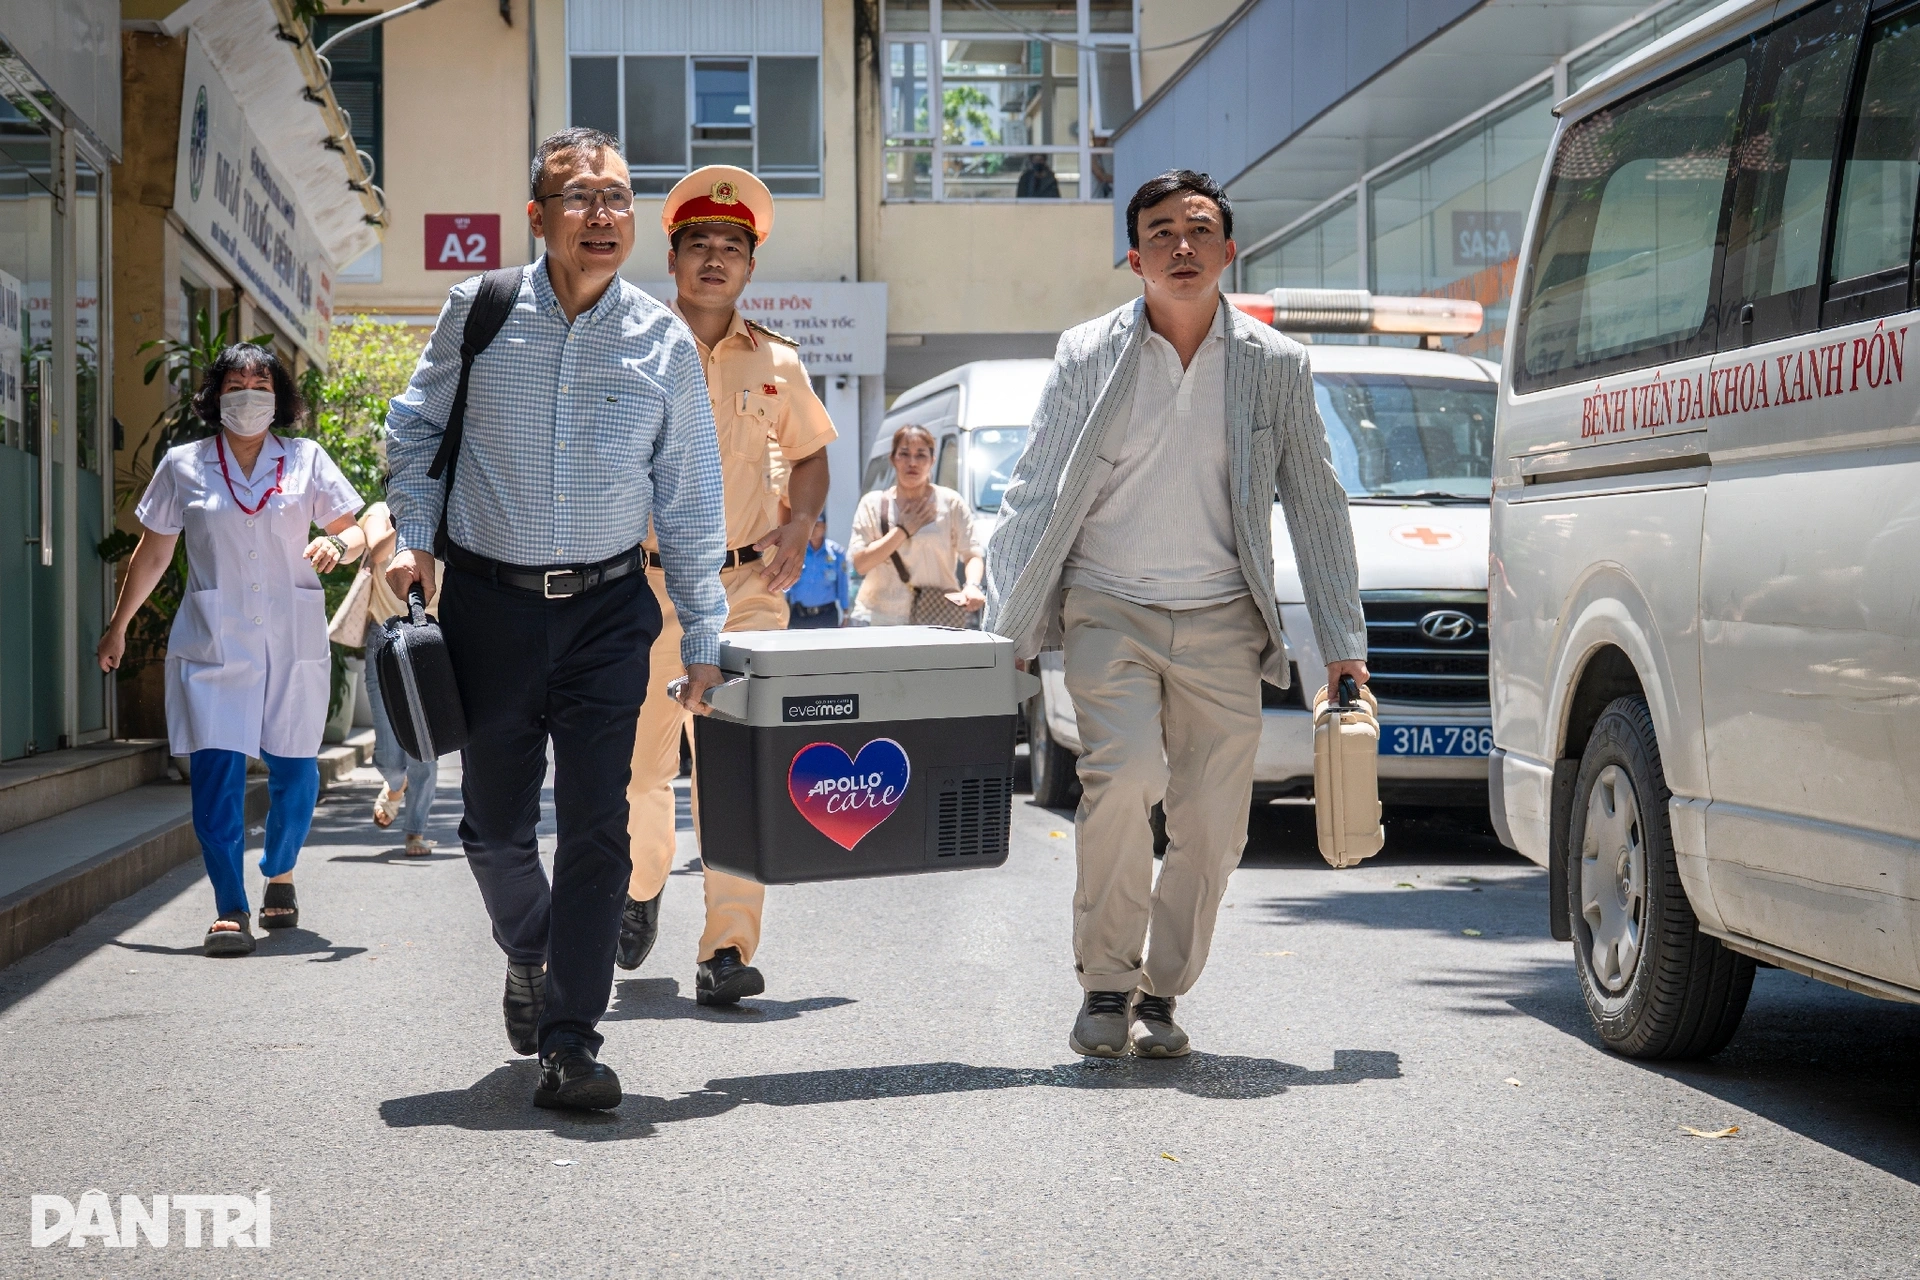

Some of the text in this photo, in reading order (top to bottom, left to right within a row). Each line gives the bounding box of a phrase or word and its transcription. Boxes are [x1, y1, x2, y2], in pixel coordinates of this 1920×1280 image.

[439, 233, 486, 263] A2
[779, 295, 813, 311] PÔN
[800, 351, 853, 364] IỆT NAM
[1581, 383, 1629, 443] BỆNH
[1630, 369, 1676, 435] VIỆN
[1676, 373, 1706, 424] ĐA
[1707, 359, 1770, 418] KHOA
[1774, 341, 1847, 407] XANH
[1849, 319, 1909, 393] PÔN
[788, 699, 853, 717] evermed
[808, 772, 882, 797] APOLLO
[827, 786, 897, 814] care
